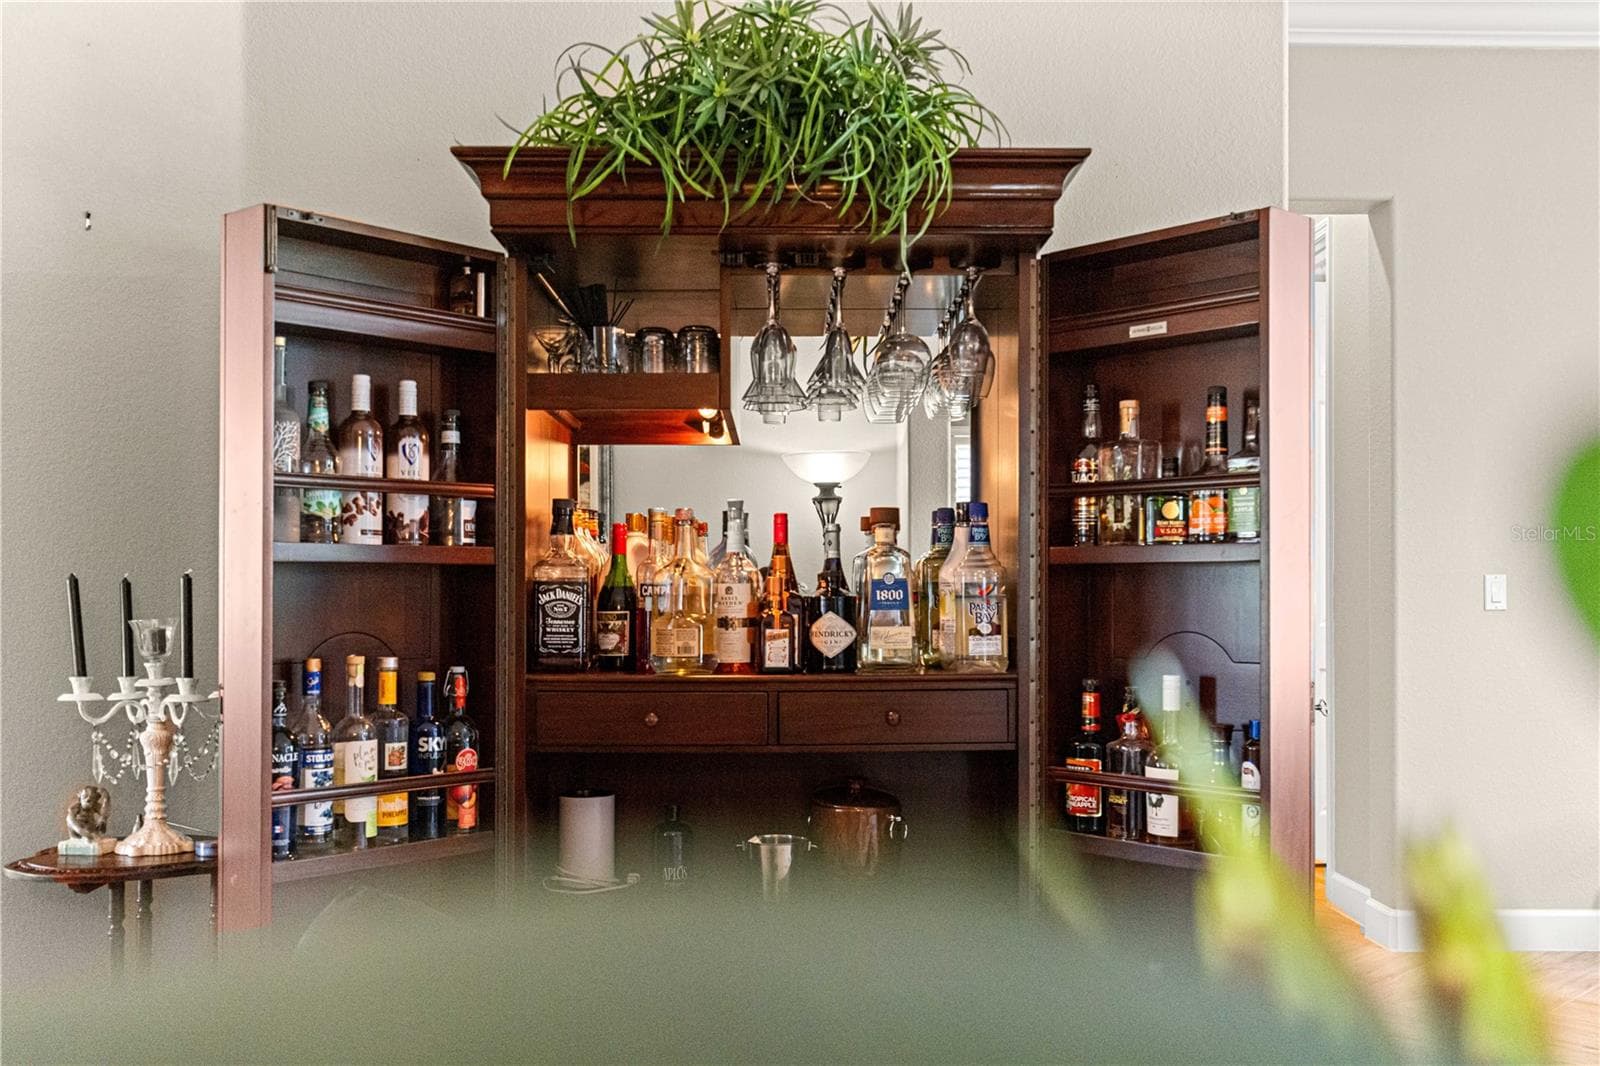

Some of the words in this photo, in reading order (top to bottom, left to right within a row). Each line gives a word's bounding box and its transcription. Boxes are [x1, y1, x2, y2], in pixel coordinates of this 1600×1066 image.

[538, 591, 555, 605] JACK
[555, 588, 584, 606] DANIEL'S
[876, 589, 904, 601] 1800
[968, 601, 1001, 616] PARROT
[975, 612, 996, 625] BAY
